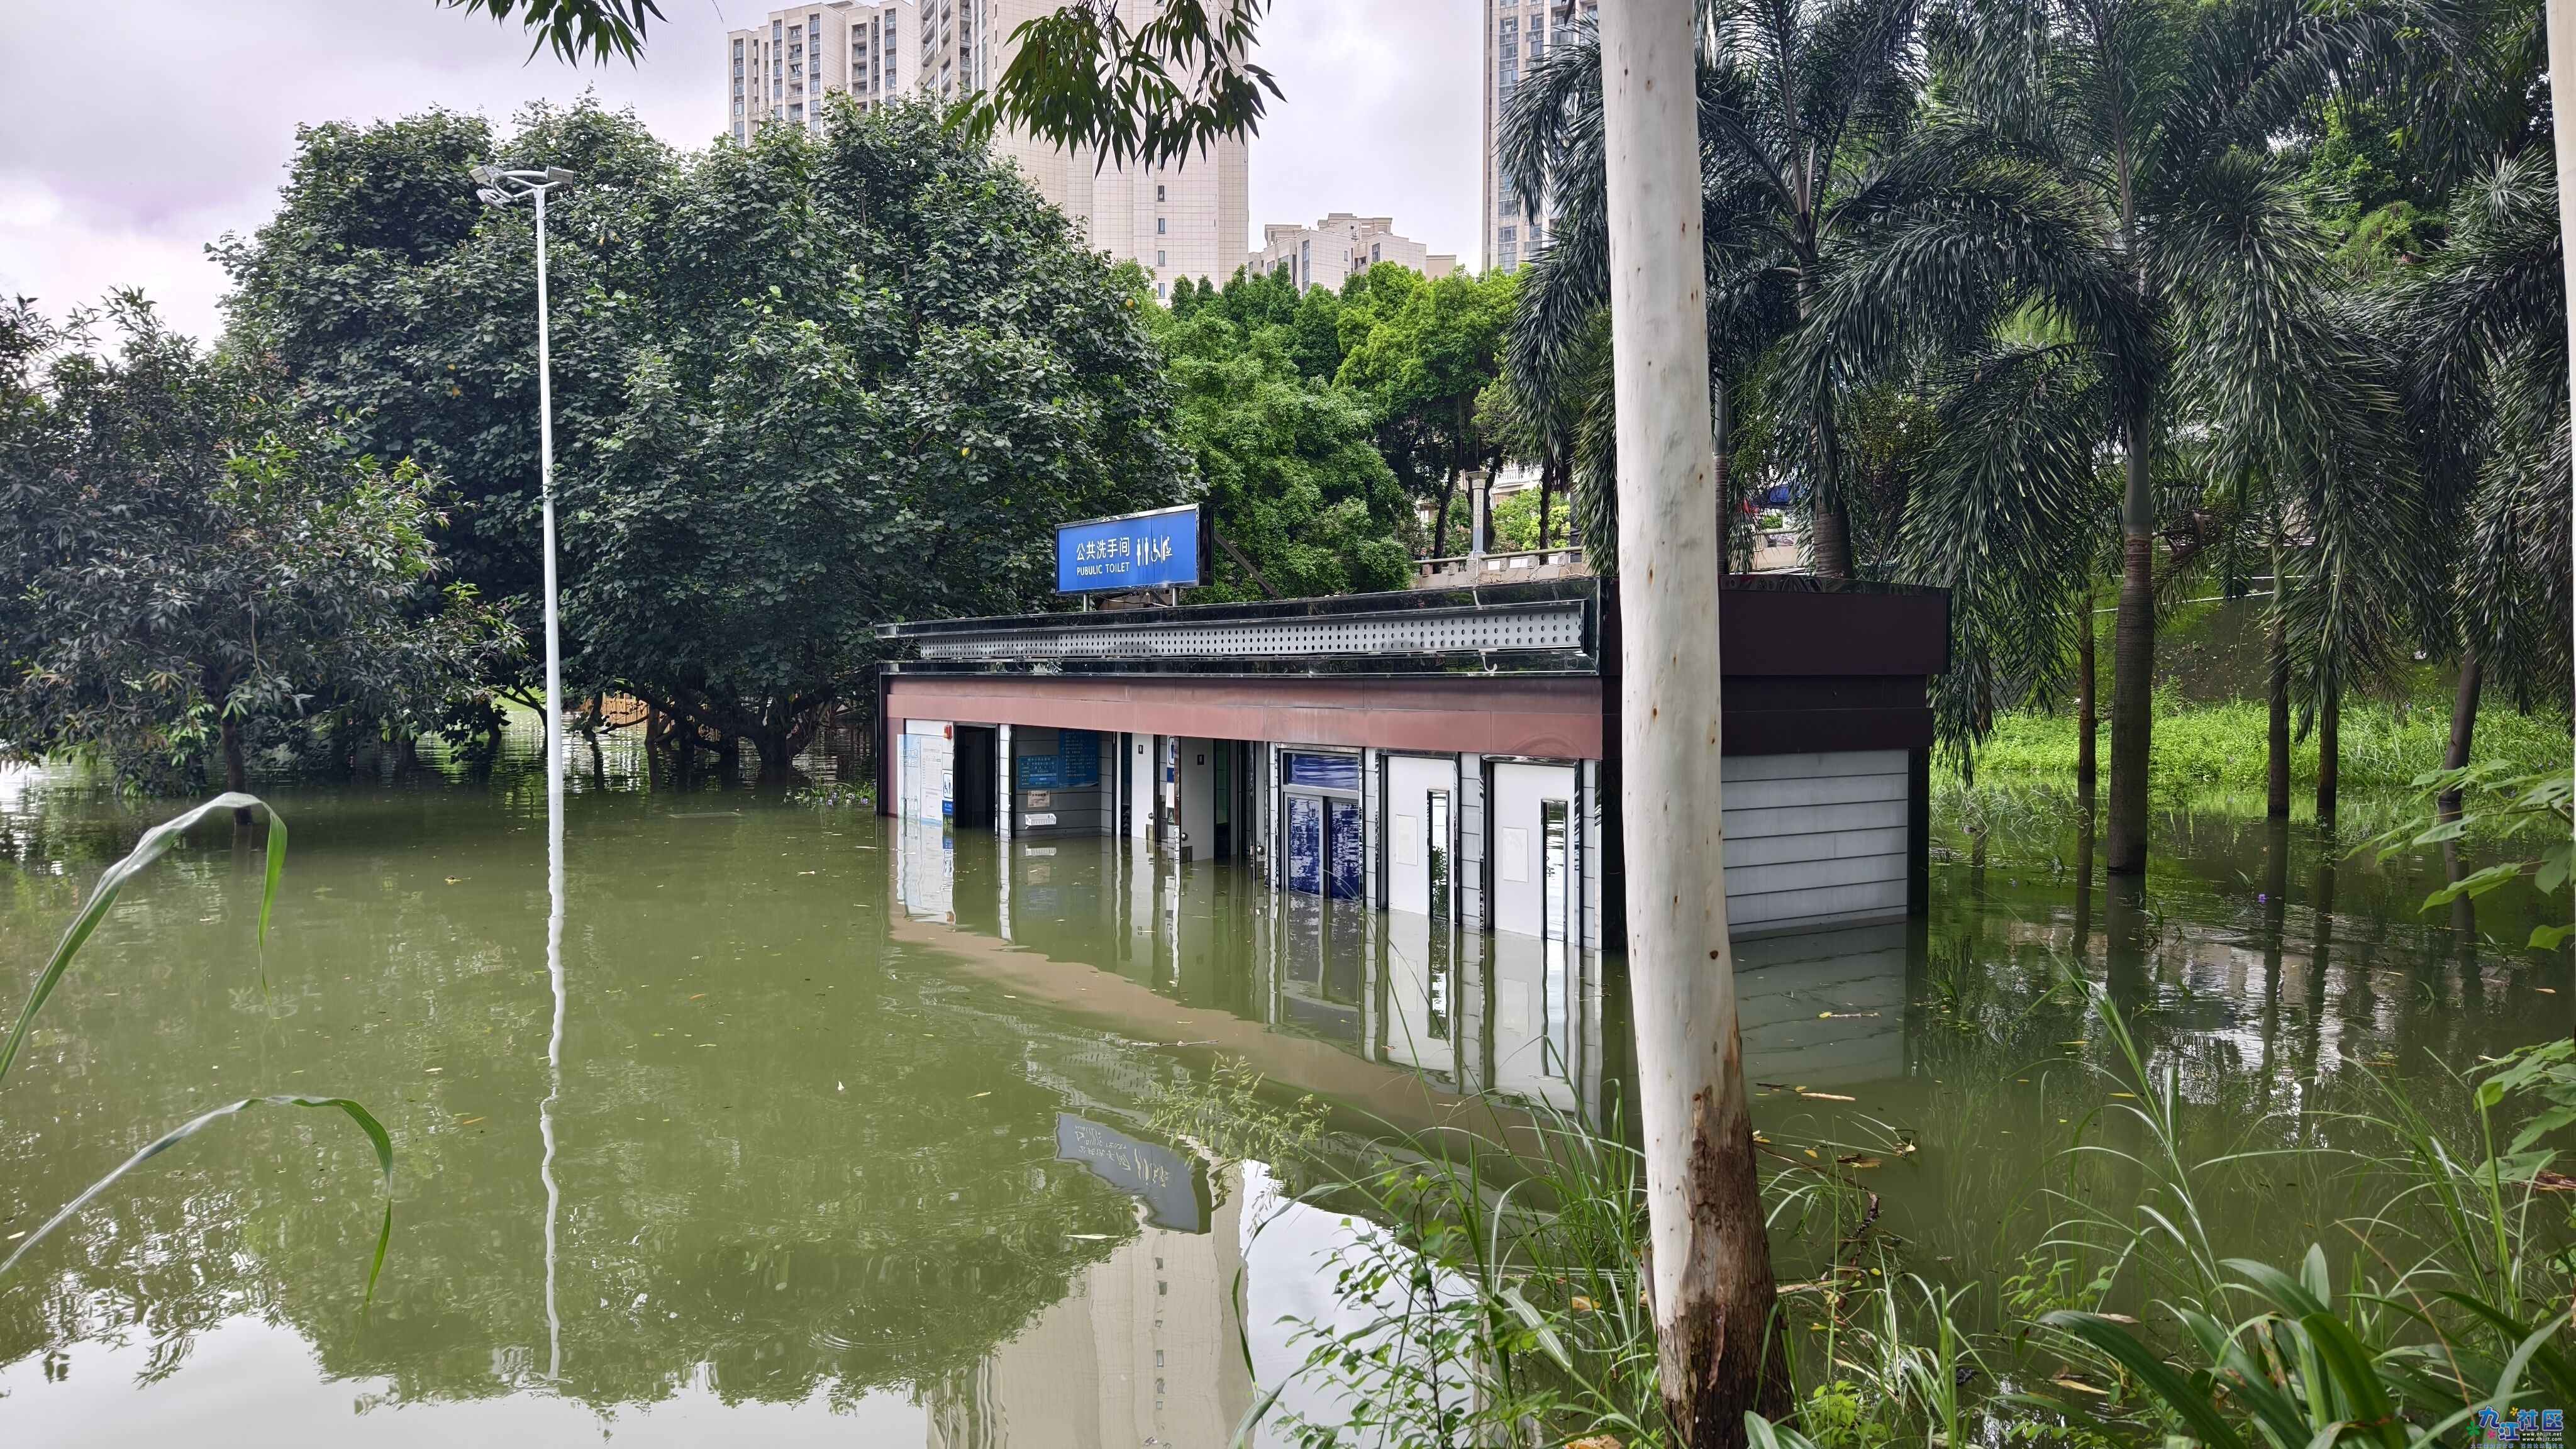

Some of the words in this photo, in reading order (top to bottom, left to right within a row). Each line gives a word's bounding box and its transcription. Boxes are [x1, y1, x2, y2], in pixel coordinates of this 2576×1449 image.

[1076, 536, 1130, 562] 公共洗手间
[1077, 564, 1103, 577] PUBULIC
[1106, 562, 1130, 574] TOILET
